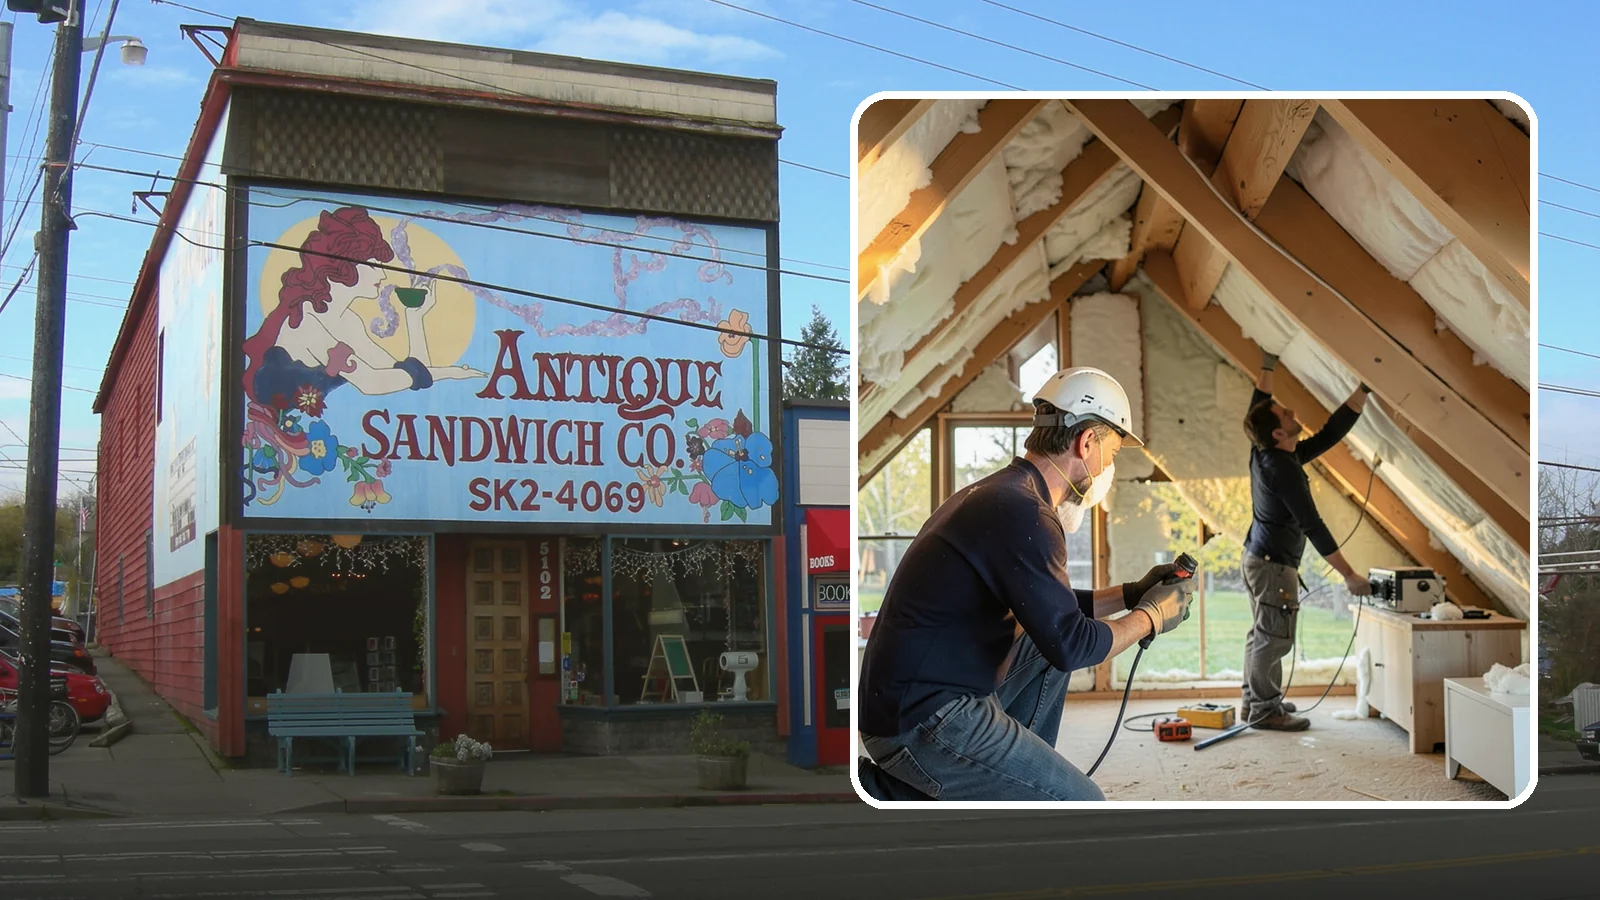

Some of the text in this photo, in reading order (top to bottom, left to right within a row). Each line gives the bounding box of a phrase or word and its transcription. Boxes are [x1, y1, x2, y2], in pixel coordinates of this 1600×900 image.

[476, 329, 723, 421] ANTIQUE
[361, 408, 684, 469] SANDWICH CO.
[468, 477, 645, 513] SK2-4069
[539, 541, 552, 600] 5102
[809, 555, 834, 569] BOOKS
